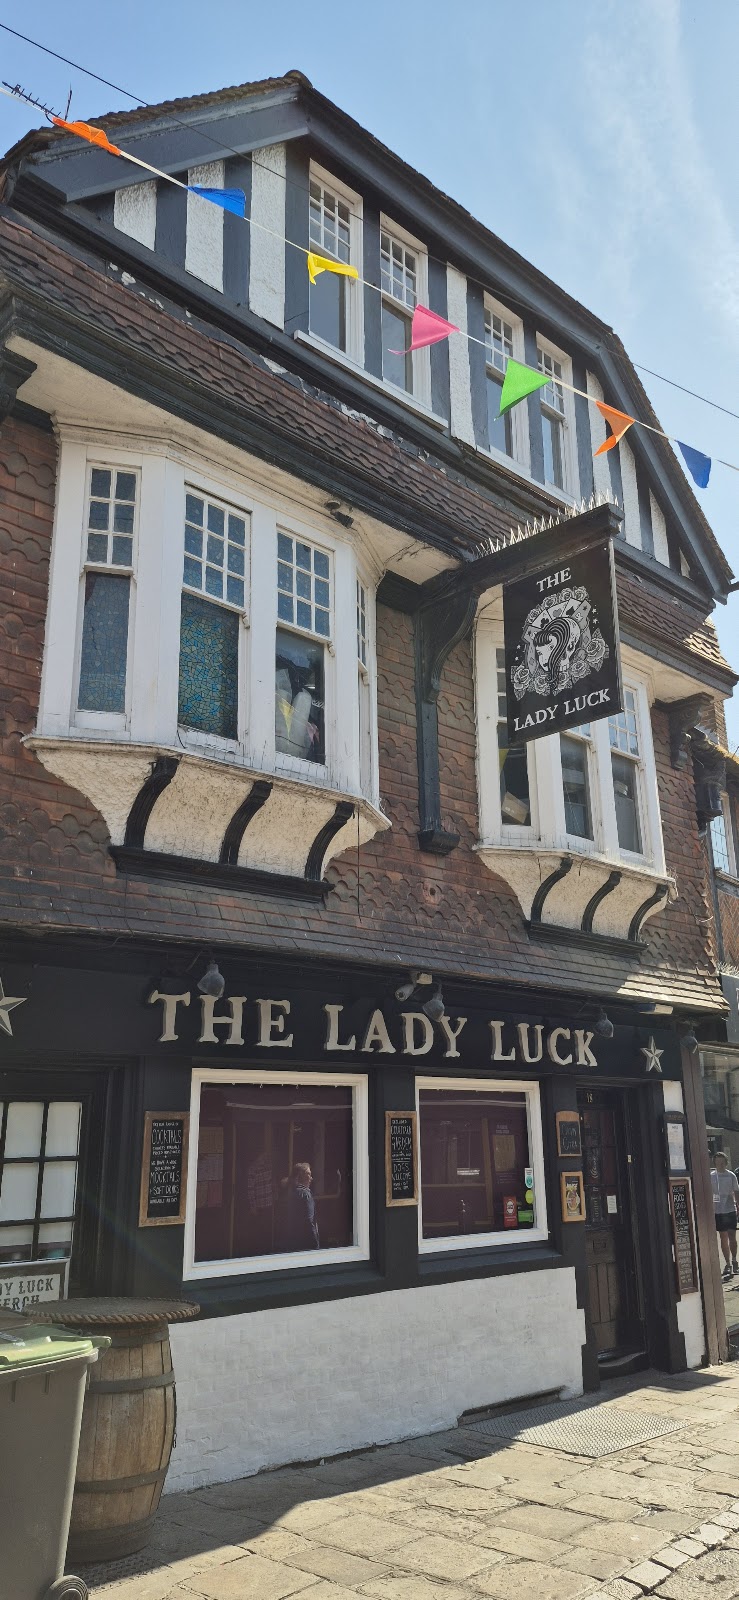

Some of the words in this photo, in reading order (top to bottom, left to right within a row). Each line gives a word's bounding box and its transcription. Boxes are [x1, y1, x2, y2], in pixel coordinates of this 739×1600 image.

[536, 567, 572, 592] THE
[513, 704, 558, 732] LADY
[563, 688, 611, 716] LUCK
[148, 989, 294, 1048] THE
[322, 1004, 468, 1058] LADY
[488, 1020, 598, 1067] LUCK
[19, 1277, 54, 1294] LUCK
[0, 1294, 40, 1311] ERCH
